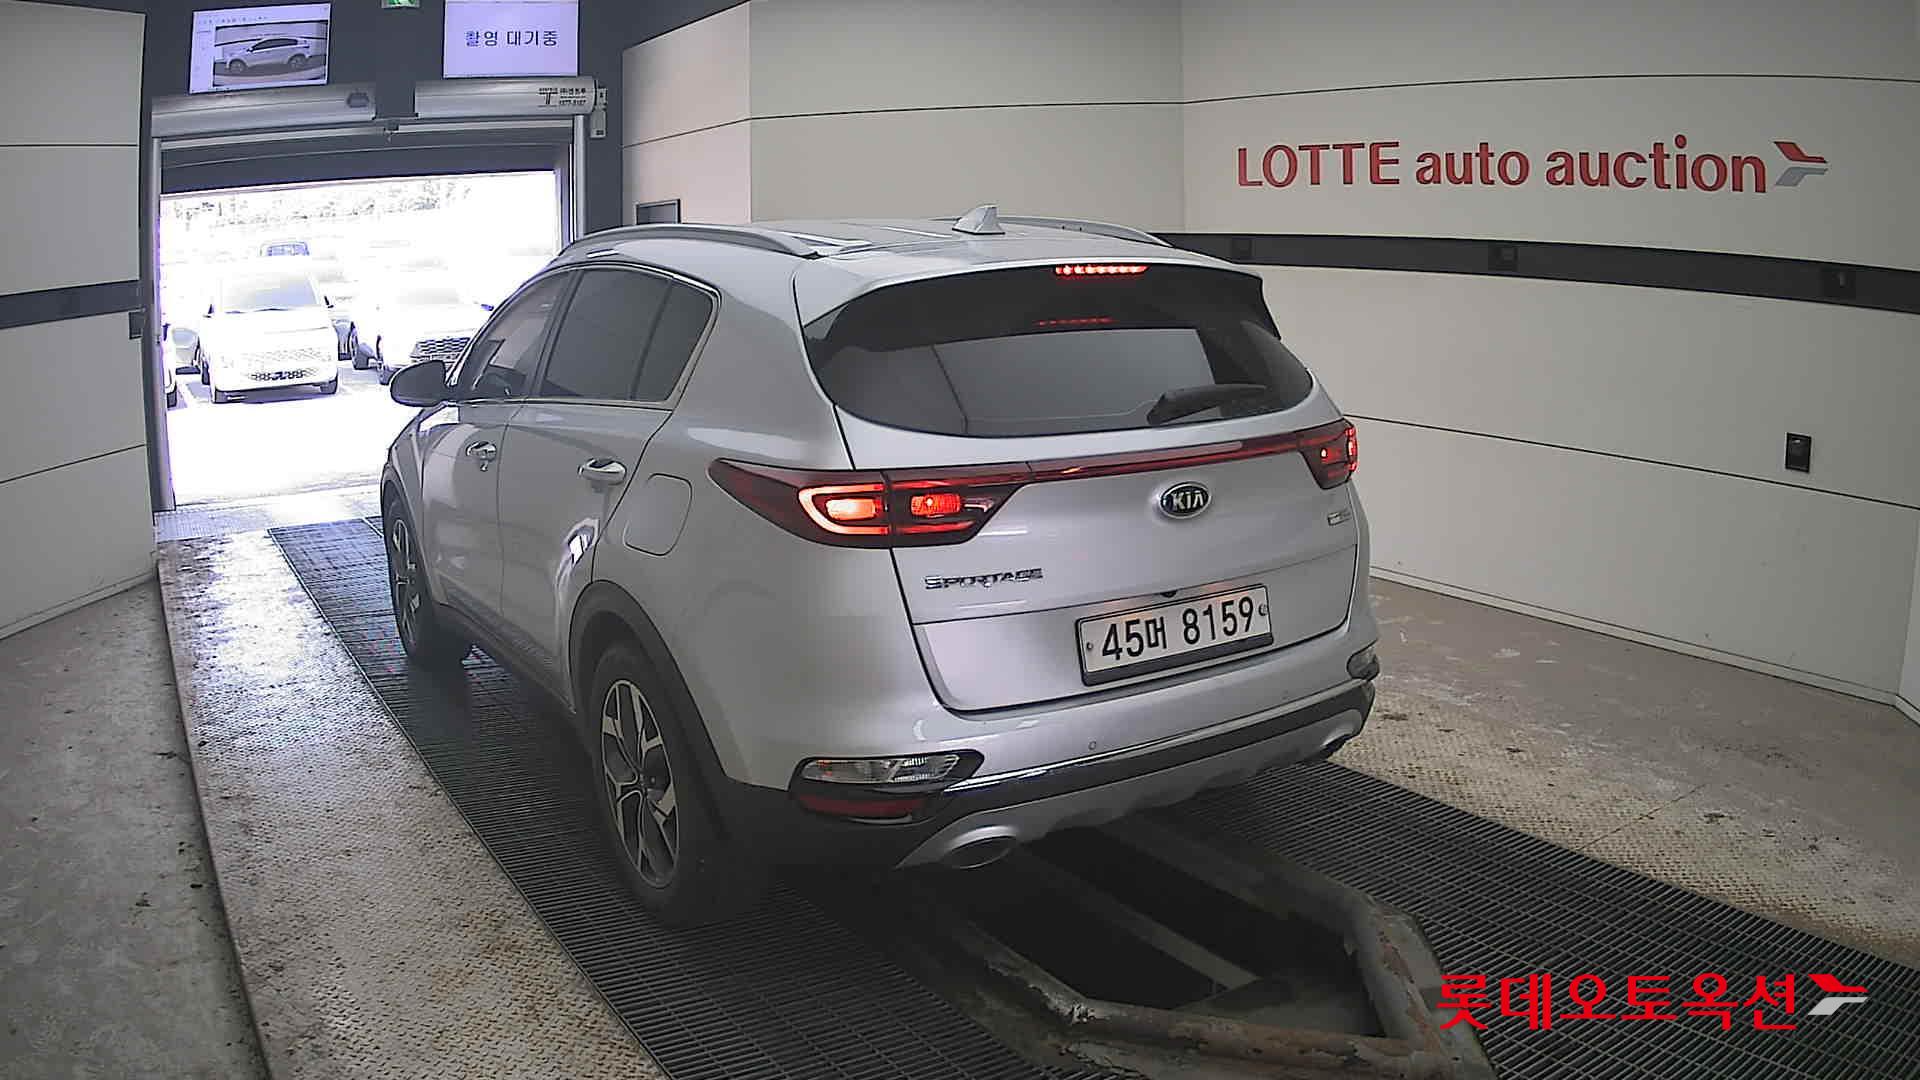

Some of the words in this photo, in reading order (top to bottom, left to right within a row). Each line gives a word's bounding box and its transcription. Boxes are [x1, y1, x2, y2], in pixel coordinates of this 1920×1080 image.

[506, 30, 558, 47] 대기중
[1238, 141, 1400, 188] LOTTE
[1415, 142, 1530, 186] auto
[1545, 134, 1767, 193] auction
[1170, 490, 1203, 511] KIA
[924, 567, 1043, 590] SPORTAGE
[1102, 616, 1167, 661] 45머
[1182, 596, 1254, 645] 8159
